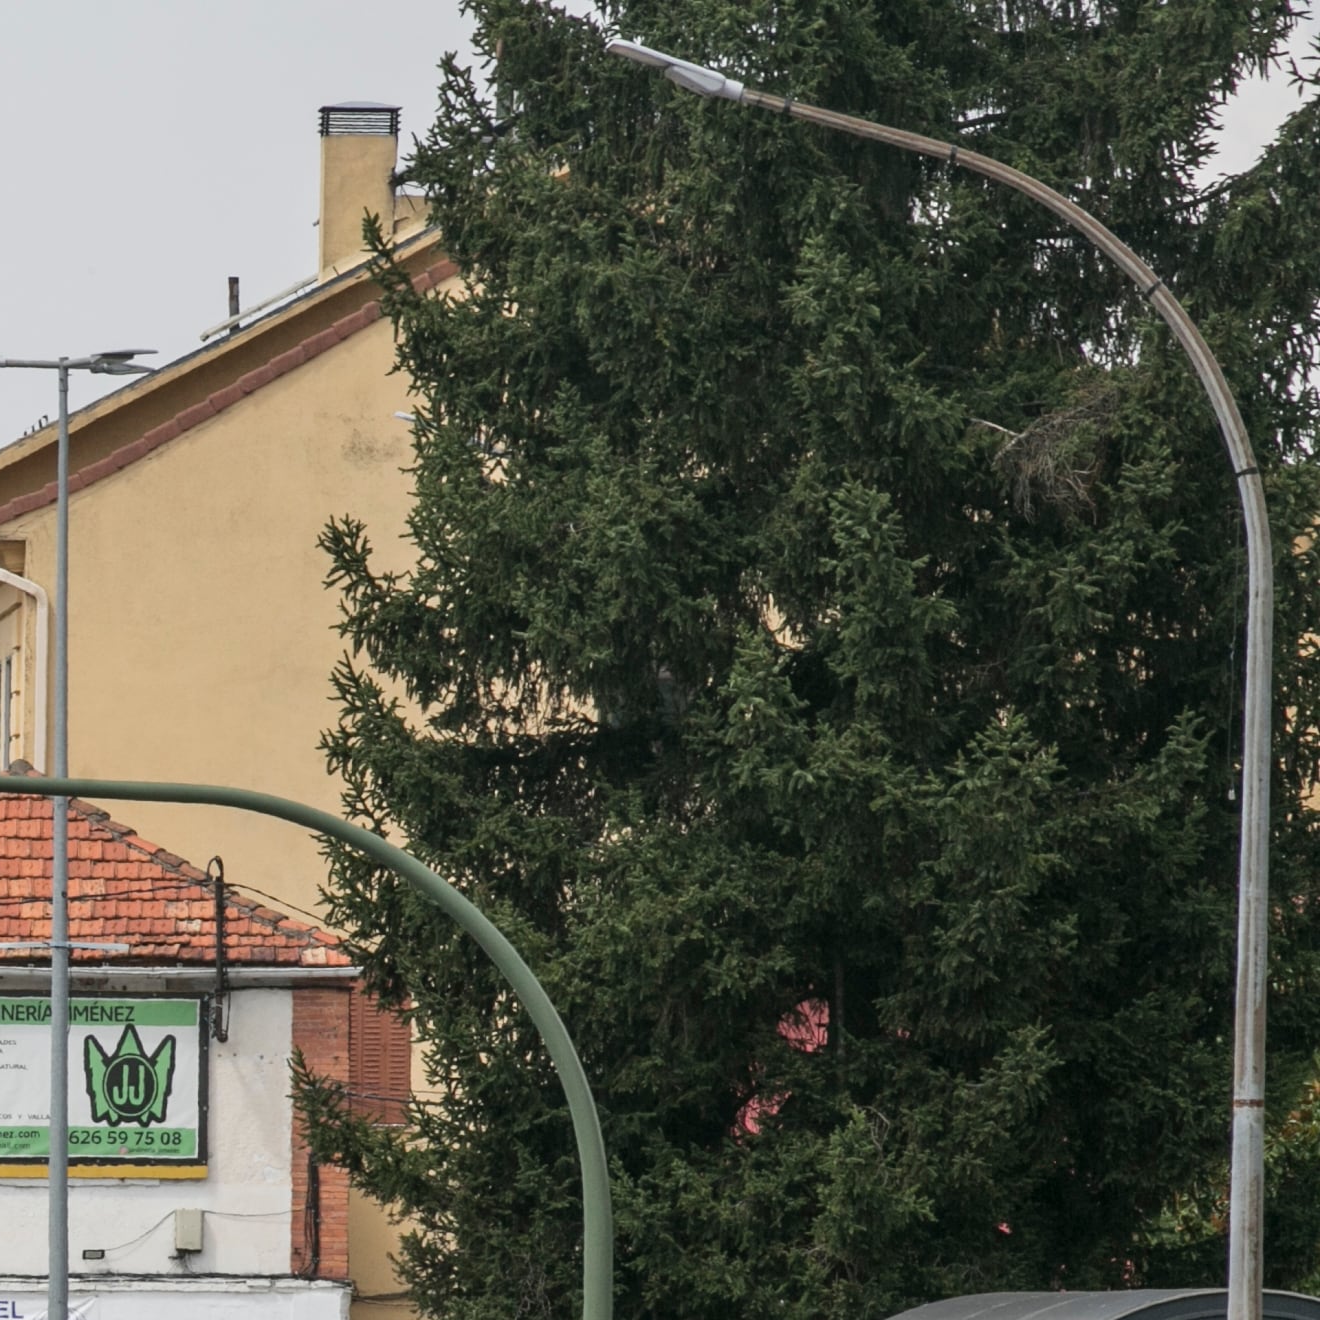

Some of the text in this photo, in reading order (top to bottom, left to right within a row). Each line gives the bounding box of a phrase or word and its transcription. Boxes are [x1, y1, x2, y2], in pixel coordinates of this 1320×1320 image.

[68, 1004, 136, 1022] IMÉNEZ
[69, 1130, 183, 1146] 626 59 75 08
